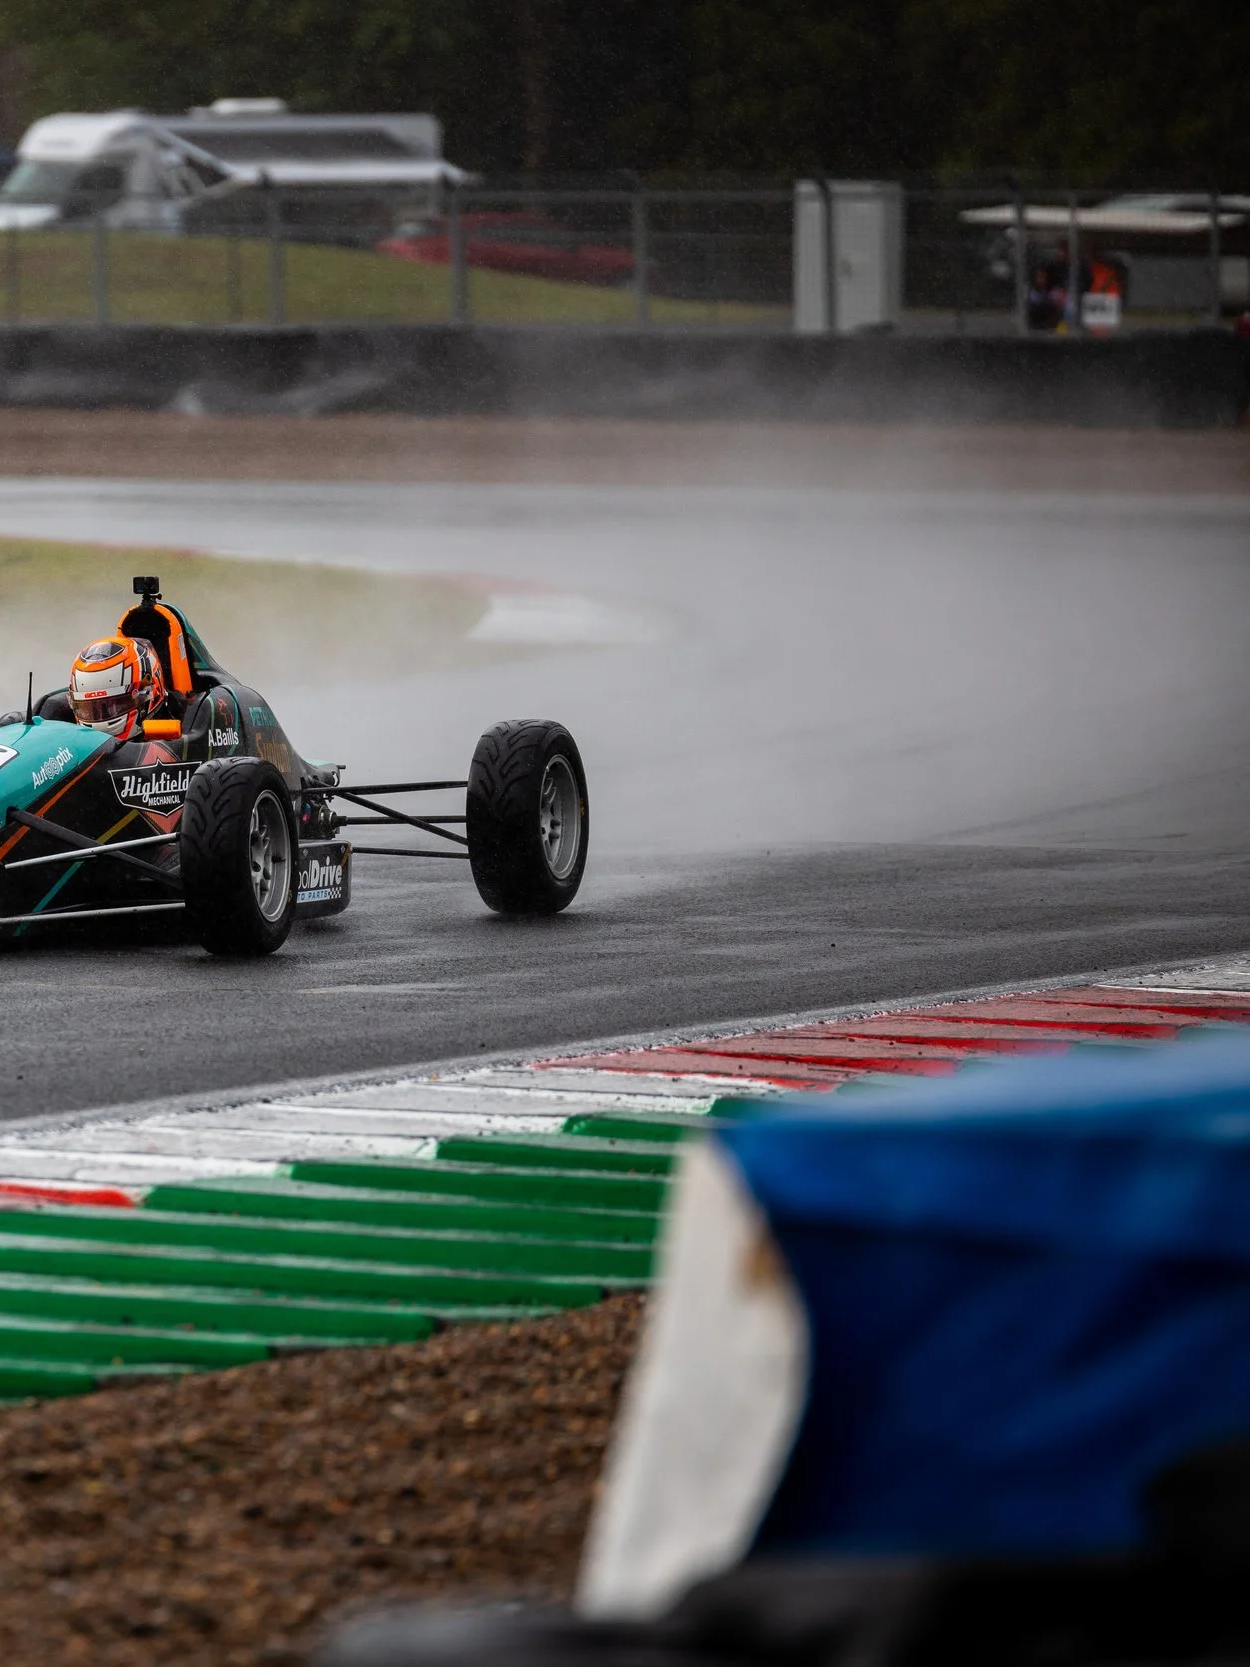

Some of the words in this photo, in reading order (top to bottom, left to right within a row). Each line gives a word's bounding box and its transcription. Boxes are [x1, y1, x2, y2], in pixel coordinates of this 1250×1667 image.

[208, 727, 239, 747] A.Baills
[121, 770, 191, 803] Highfield
[148, 795, 181, 806] MECHANICAL
[308, 890, 328, 898] PARTS
